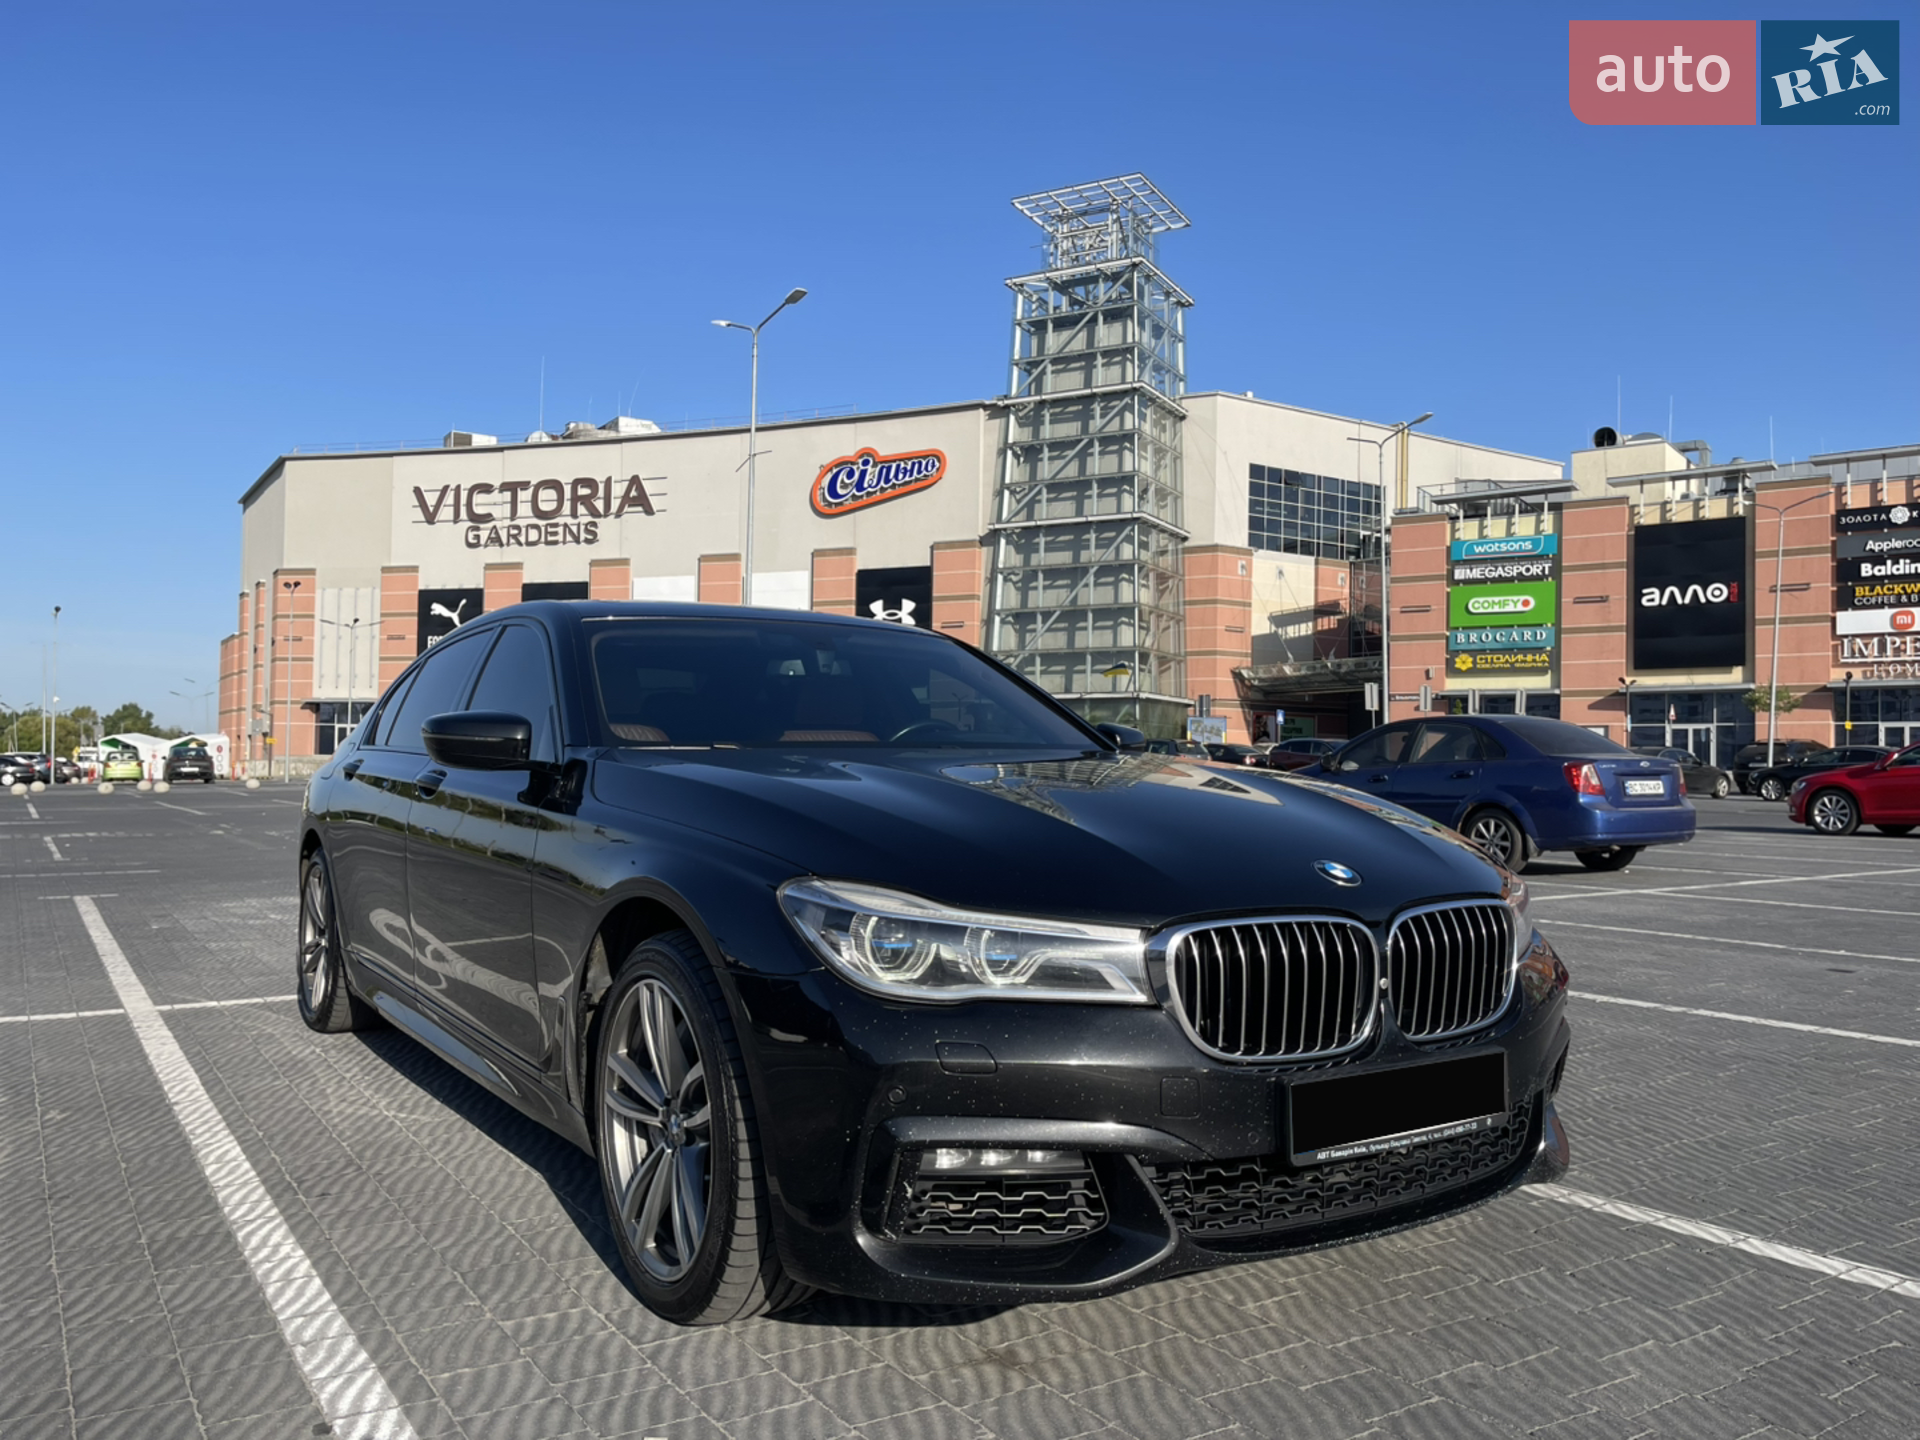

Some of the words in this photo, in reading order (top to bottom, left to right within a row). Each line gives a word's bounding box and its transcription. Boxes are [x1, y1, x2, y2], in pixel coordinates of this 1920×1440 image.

[825, 457, 939, 502] Сільпо
[413, 474, 656, 525] VICTORIA
[464, 520, 599, 549] GARDENS
[1473, 540, 1533, 553] watsons
[1466, 563, 1552, 579] MEGASPORT
[1860, 559, 1920, 577] Baldin
[1471, 599, 1520, 611] COMFY
[1854, 594, 1896, 606] COFFEE
[1456, 629, 1546, 644] BROCARD
[1842, 636, 1920, 657] IMPE
[1476, 653, 1549, 664] СТОЛИЧНА
